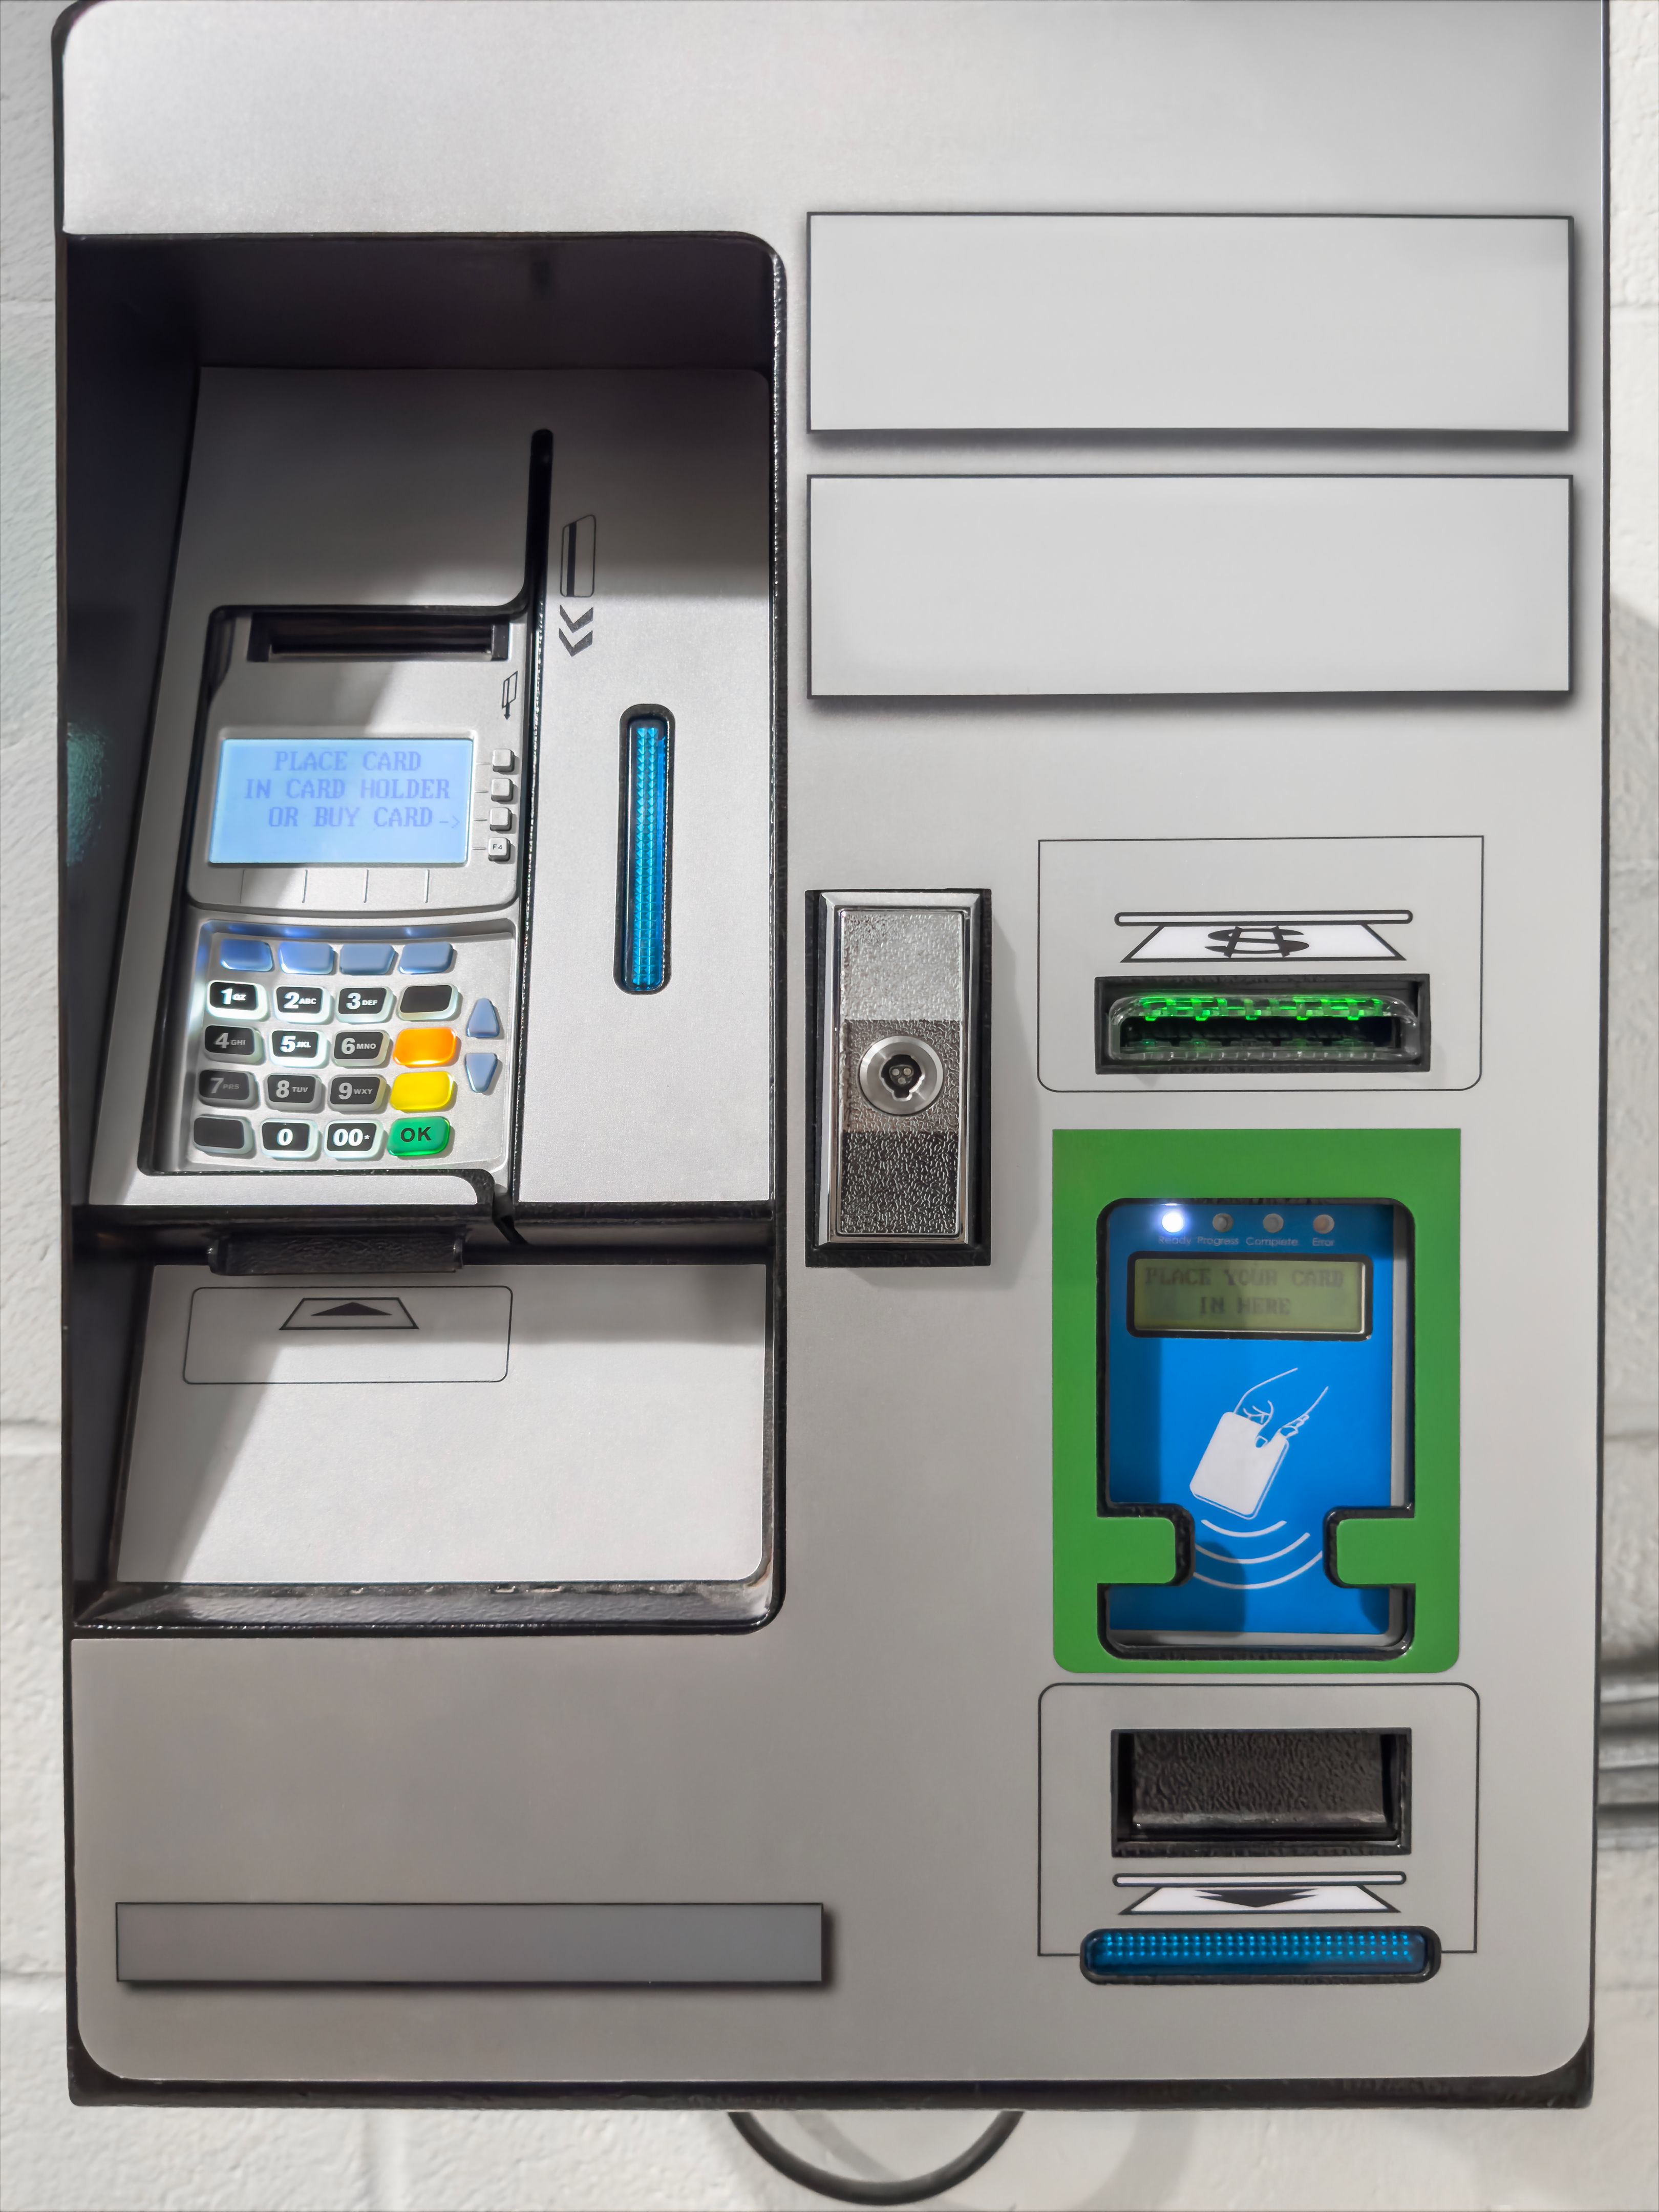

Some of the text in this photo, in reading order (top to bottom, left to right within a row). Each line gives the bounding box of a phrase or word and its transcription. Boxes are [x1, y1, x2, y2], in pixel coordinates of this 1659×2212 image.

[274, 751, 421, 771] PLACE CARD
[245, 779, 450, 799] IN CARD HOLDER
[268, 807, 298, 827] OR
[314, 807, 360, 827] BUY
[277, 1129, 293, 1146] 0
[400, 1126, 432, 1143] OK
[1159, 1236, 1334, 1246] Ready Progress Complete Error
[1145, 1267, 1345, 1288] PLACE YOUR CARD
[1200, 1296, 1291, 1315] IN HERE
